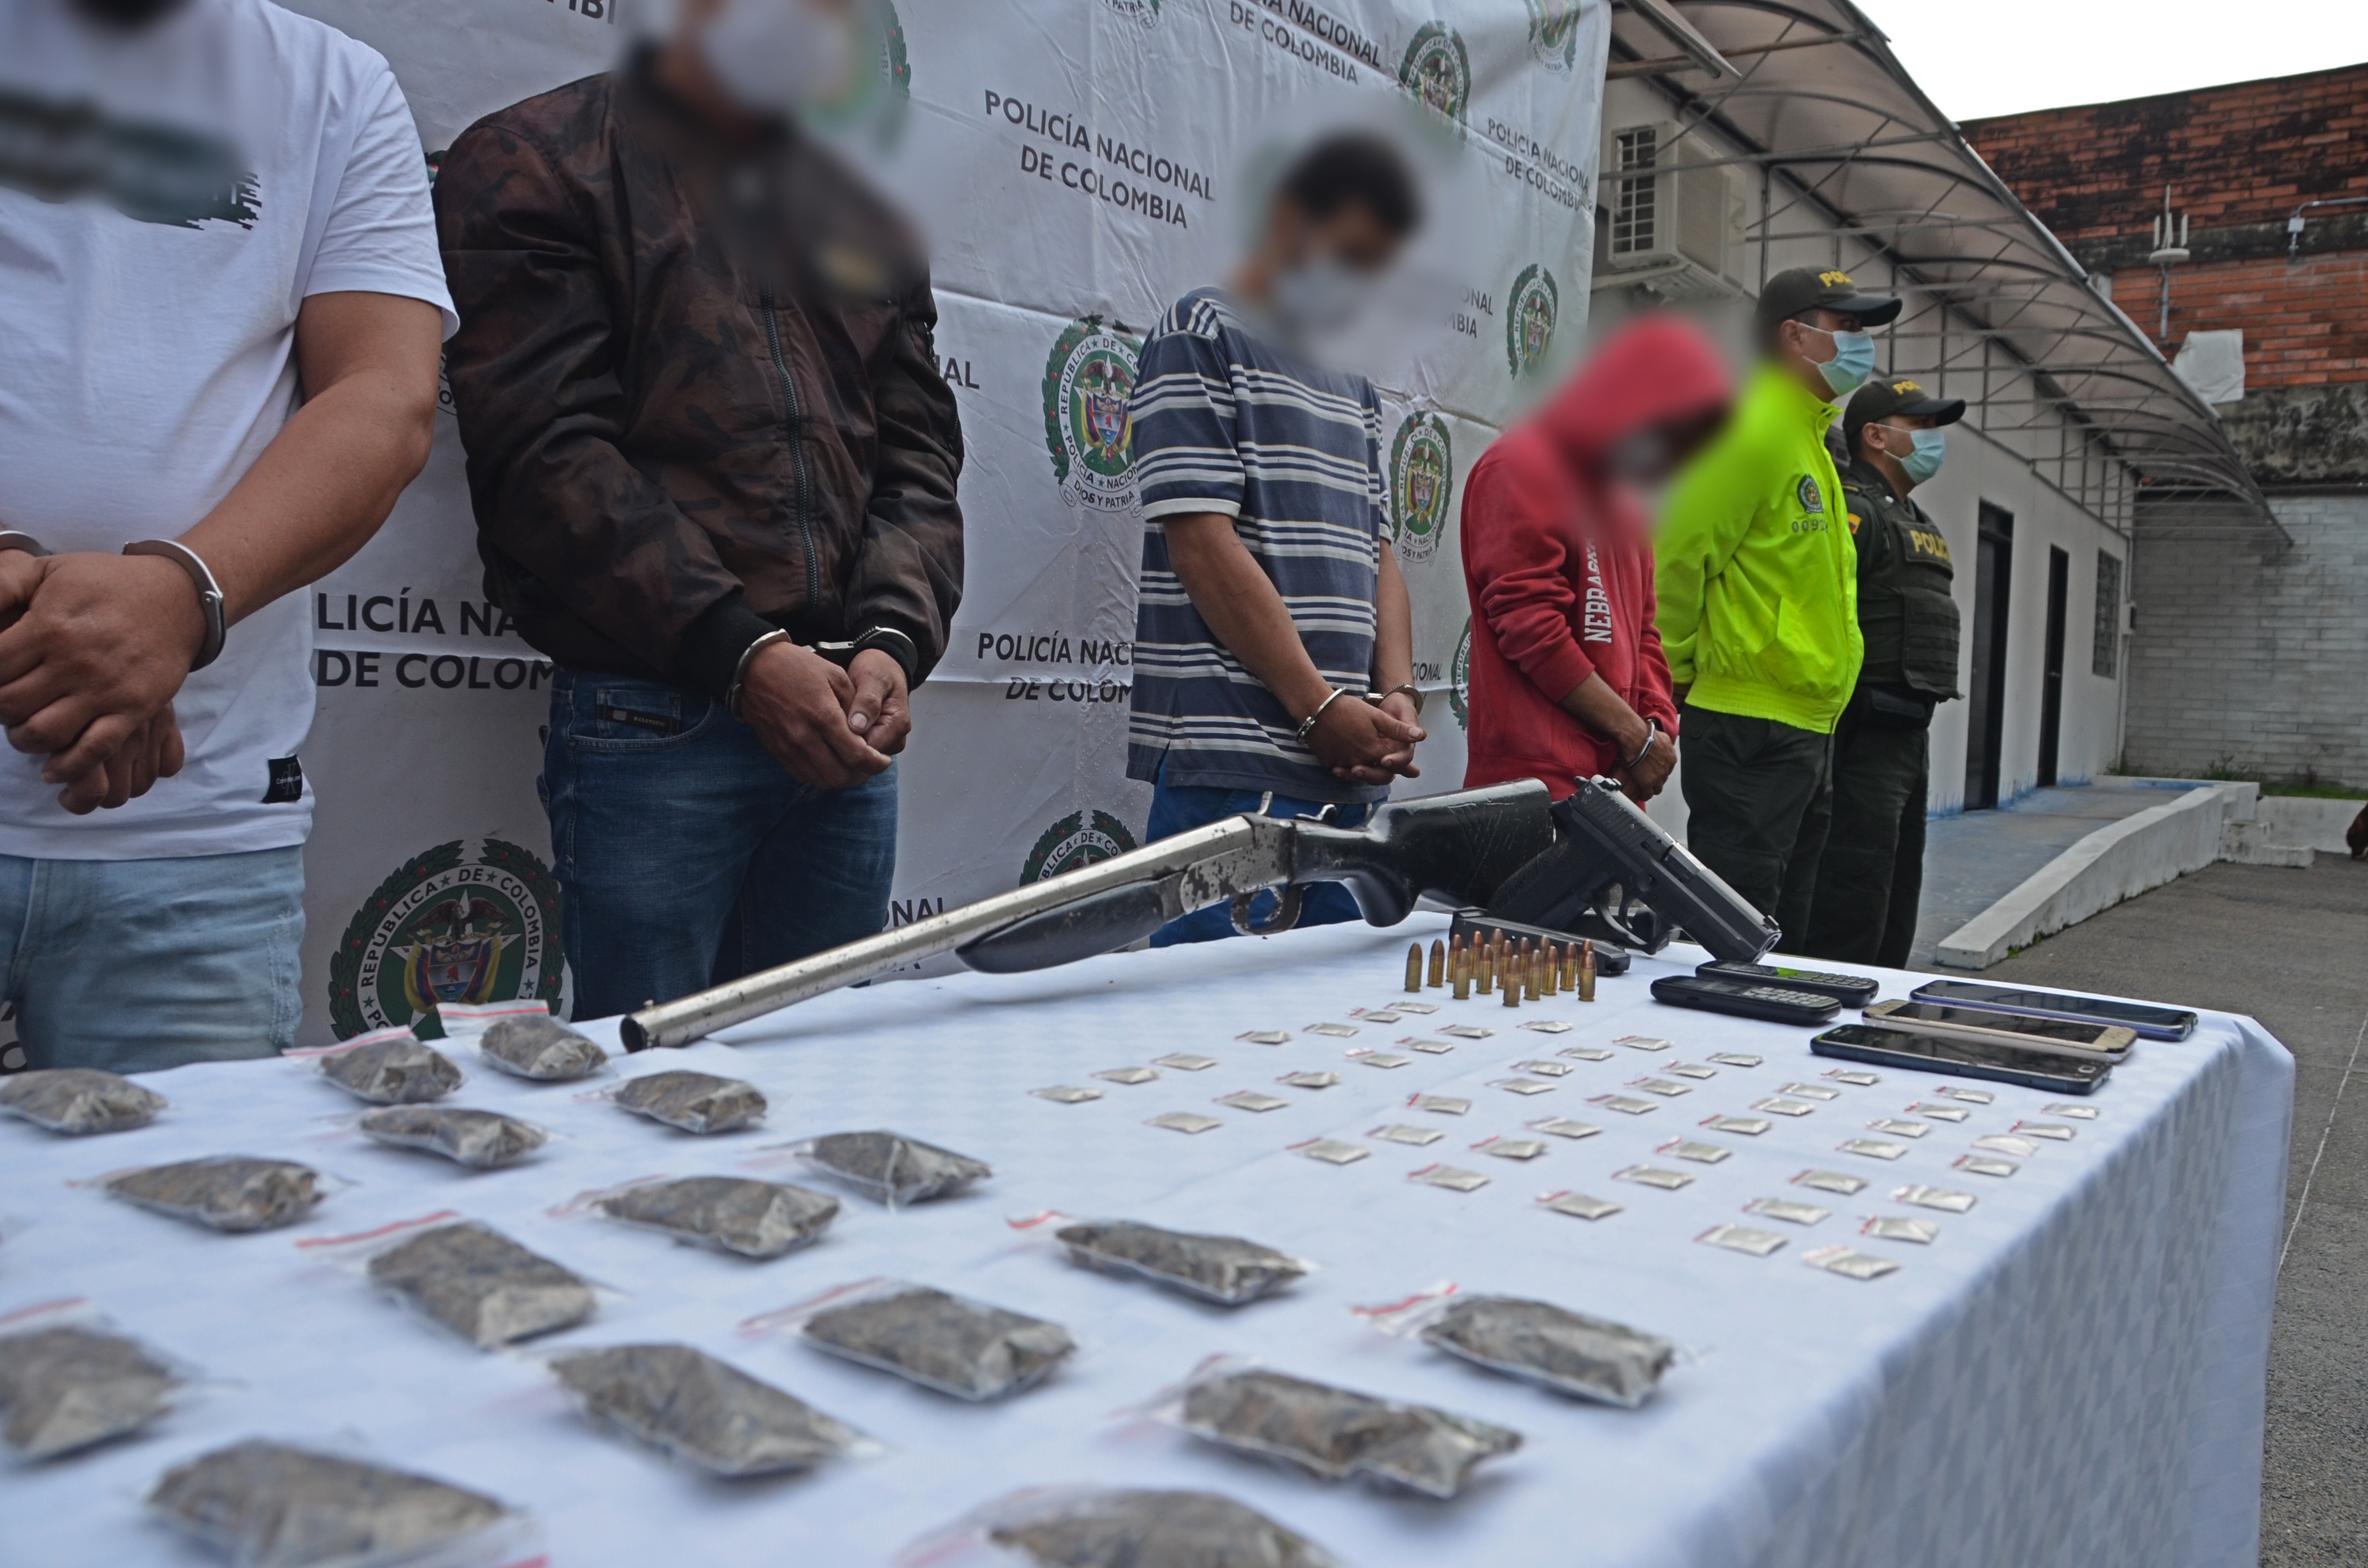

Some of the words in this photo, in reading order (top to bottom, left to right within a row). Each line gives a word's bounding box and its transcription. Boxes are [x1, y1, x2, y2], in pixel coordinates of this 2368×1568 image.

[1230, 1, 1254, 33] DE
[1262, 19, 1358, 86] COLOMBIA
[1288, 0, 1381, 68] NACIONAL
[984, 89, 1090, 152] POLICÍA
[1096, 133, 1215, 202] NACIONAL
[1488, 117, 1541, 160] POLICÍA
[1543, 147, 1590, 195] NACIONA
[1506, 155, 1522, 179] DE
[1021, 145, 1053, 181] DE
[1060, 161, 1188, 229] COLOMBIA
[1103, 338, 1116, 352] DE
[1065, 435, 1094, 484] POLICÍA
[1106, 466, 1139, 489] NACION
[1074, 480, 1096, 504] DIOS
[1097, 494, 1103, 507] Y
[1105, 490, 1135, 508] PATRIA
[317, 587, 446, 635] LICÍA
[317, 650, 381, 688] DE
[395, 653, 557, 691] COLOM
[977, 630, 1073, 664] POLICÍA
[1005, 676, 1042, 701] DE
[1048, 677, 1133, 703] COLOM
[1081, 832, 1094, 843] DE
[360, 881, 438, 988] REPÚBLICA
[457, 867, 484, 883] DE
[500, 876, 541, 970] COLOMBIA
